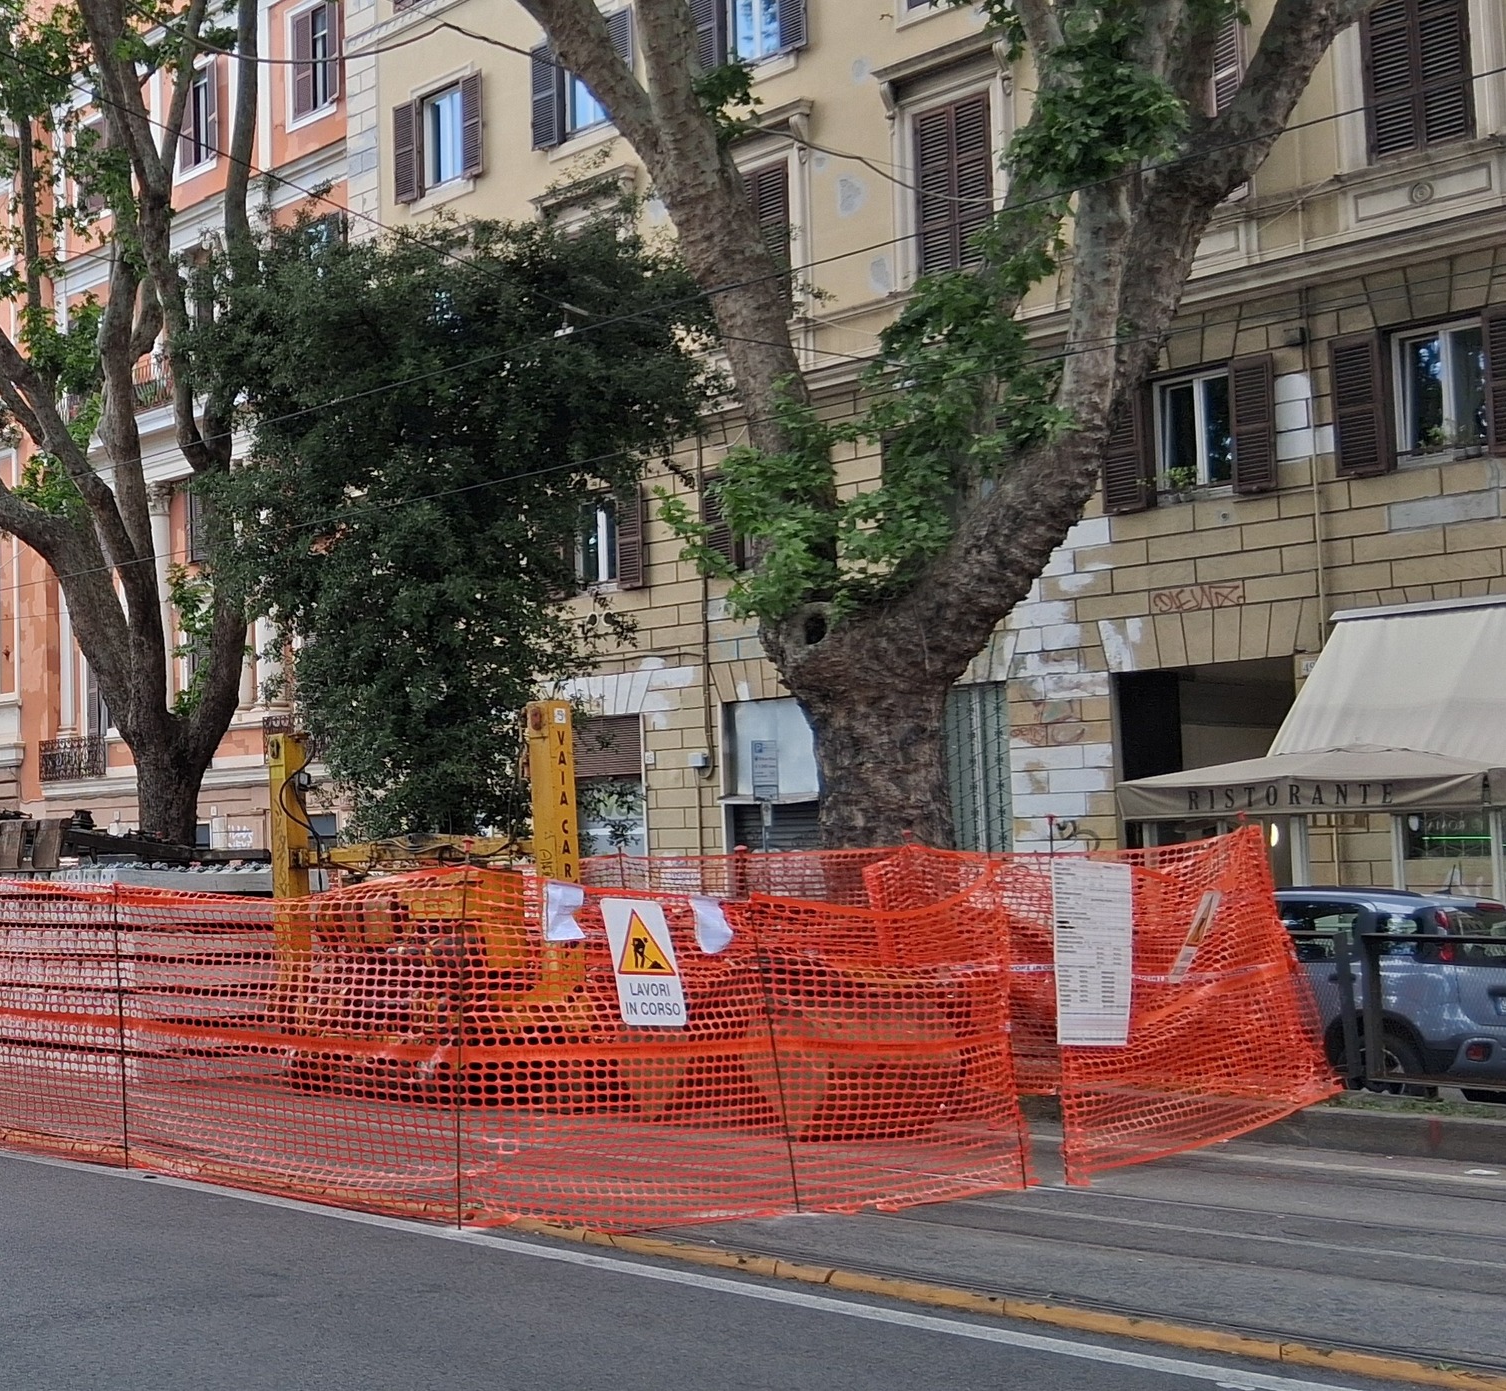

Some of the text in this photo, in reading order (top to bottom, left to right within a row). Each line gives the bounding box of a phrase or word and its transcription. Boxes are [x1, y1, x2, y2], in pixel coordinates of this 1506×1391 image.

[557, 731, 572, 878] VAIA CAR
[1188, 783, 1393, 811] RISTORANTE
[630, 982, 671, 997] LAVORI
[625, 1001, 681, 1016] IN CORSO
